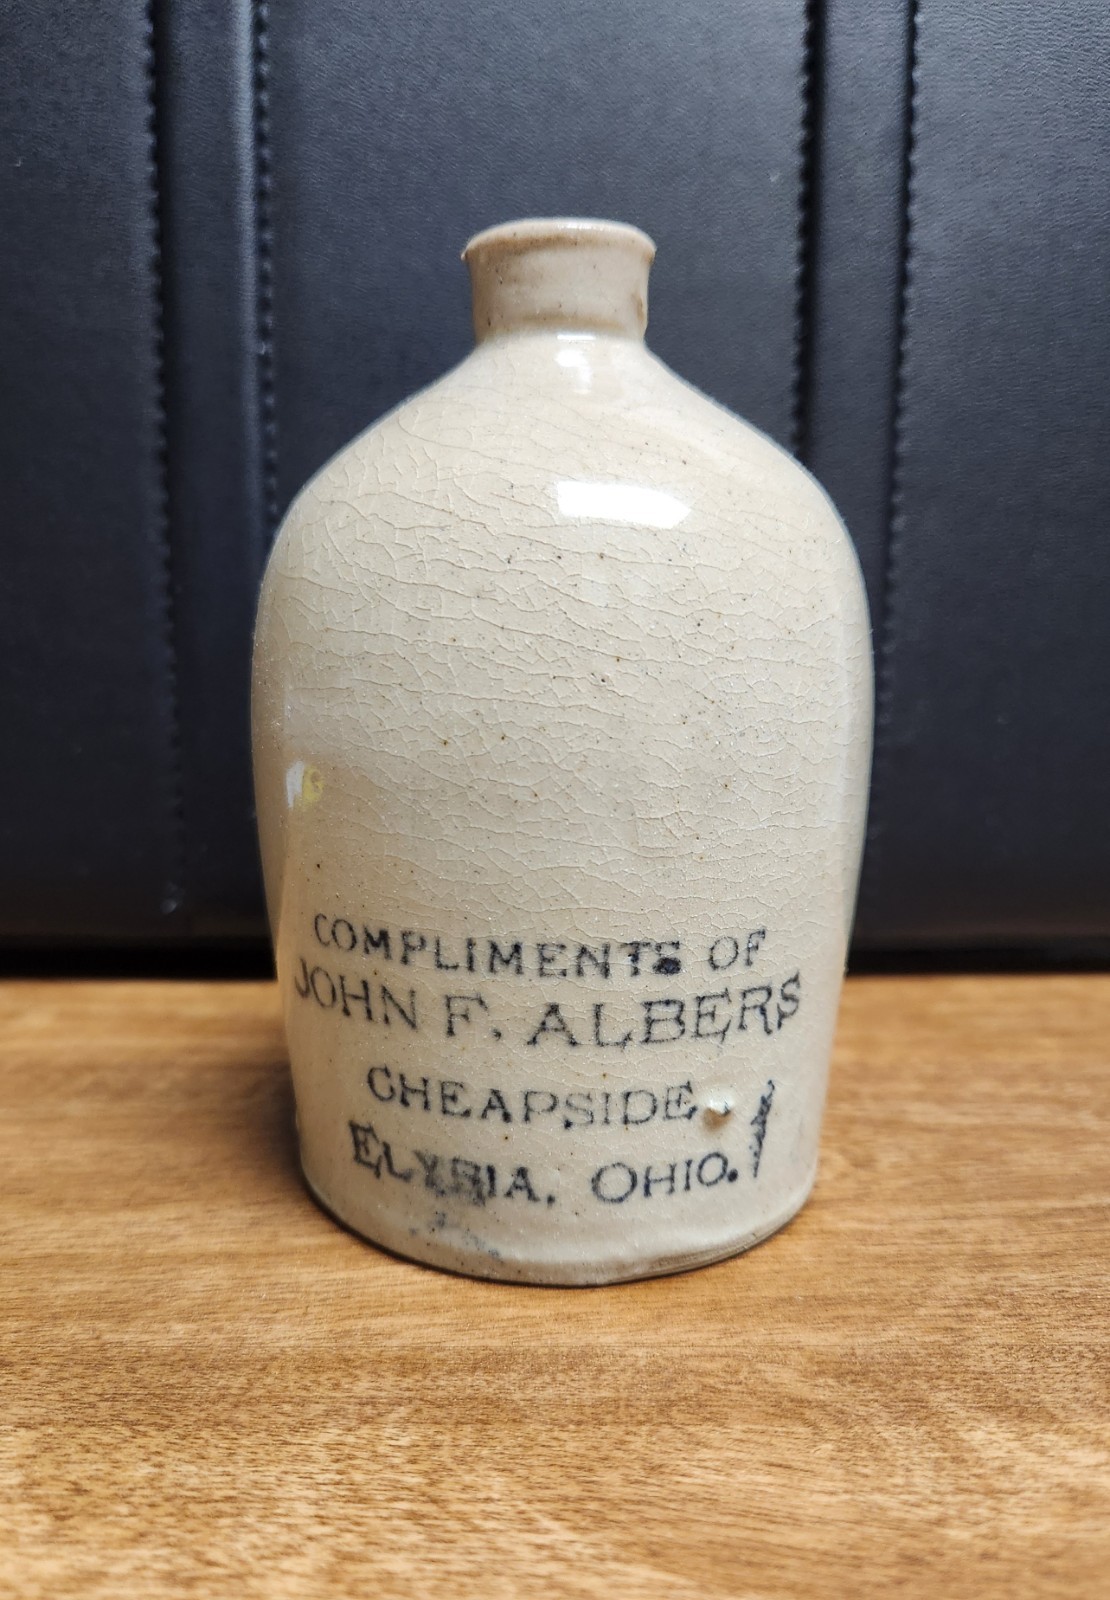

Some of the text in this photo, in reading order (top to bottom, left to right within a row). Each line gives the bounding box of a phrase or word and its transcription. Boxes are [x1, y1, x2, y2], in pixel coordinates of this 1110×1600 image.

[314, 913, 766, 979] COMPLIMENTS OF
[294, 957, 418, 1032] JOHN
[526, 970, 800, 1048] ALBERS
[591, 1151, 739, 1203] OHIO.
